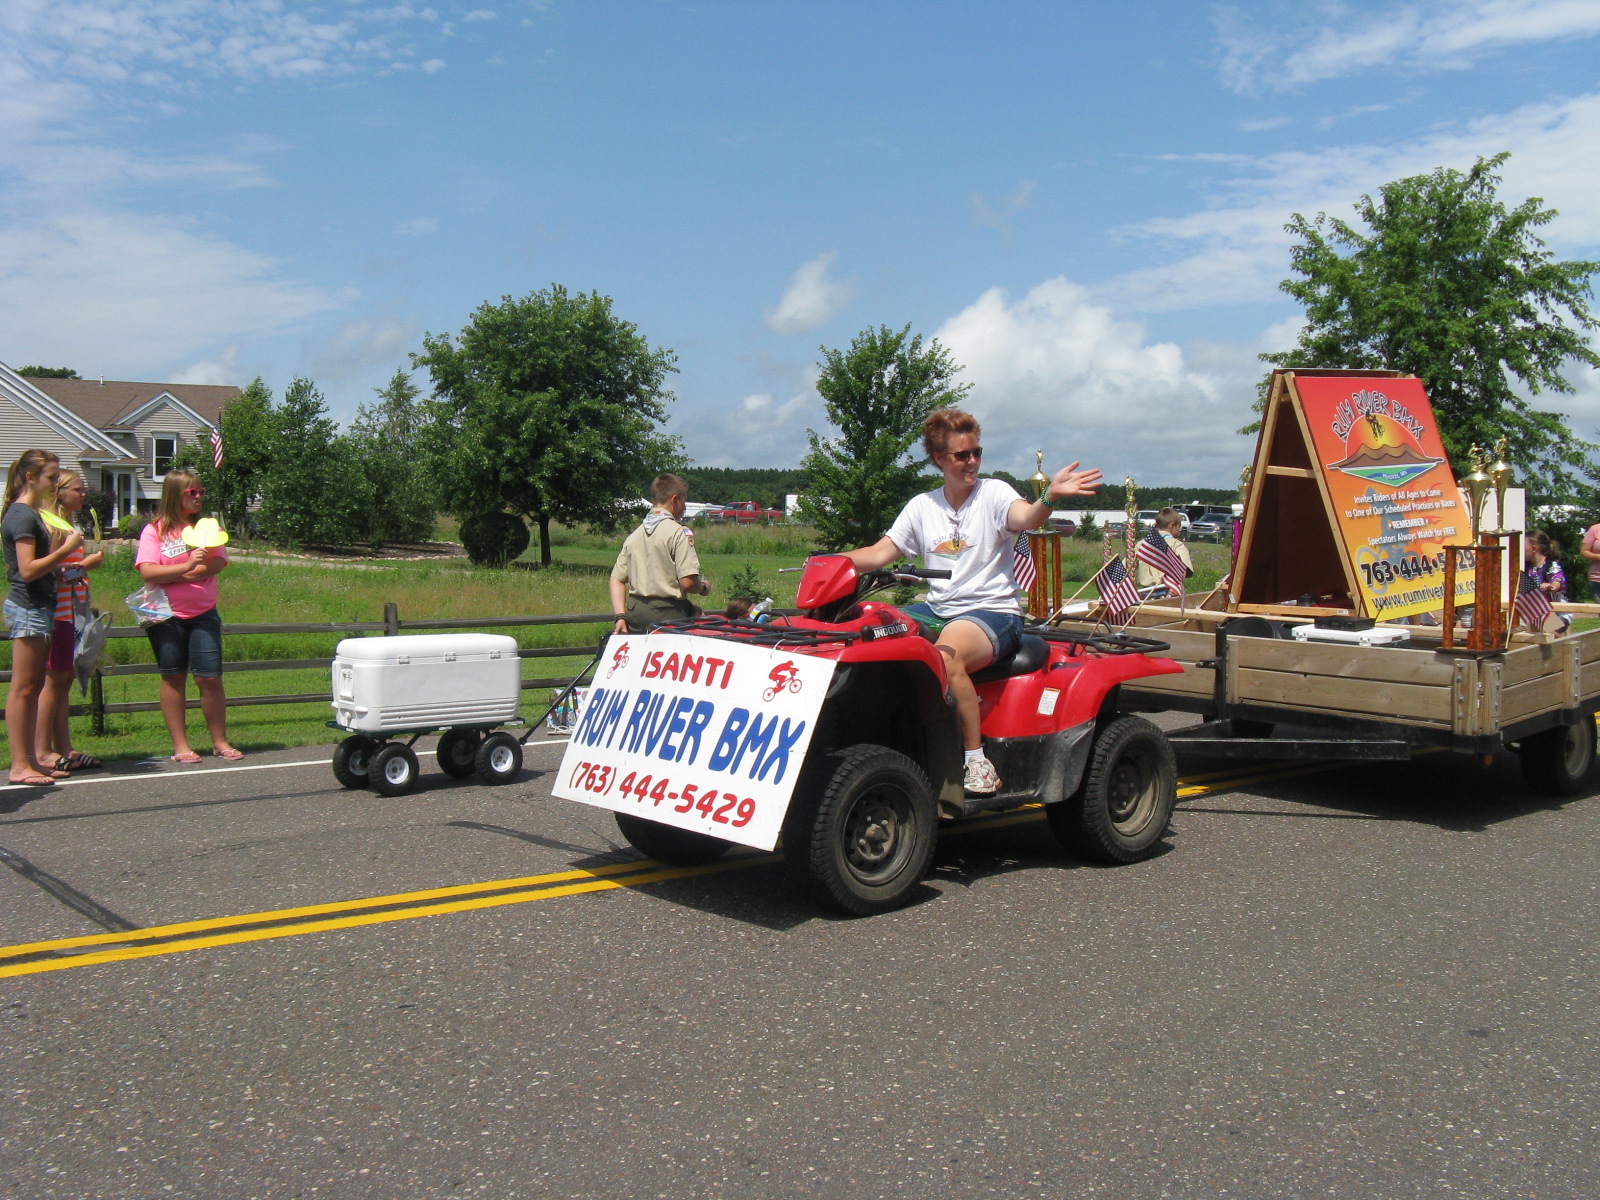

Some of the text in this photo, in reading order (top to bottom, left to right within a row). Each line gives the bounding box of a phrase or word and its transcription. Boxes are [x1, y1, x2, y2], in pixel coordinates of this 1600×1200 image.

[1332, 389, 1424, 443] RUM RIVER BMX
[1354, 494, 1373, 504] Invites
[1372, 492, 1390, 502] Riders
[1391, 491, 1397, 500] of
[1398, 490, 1406, 500] All
[1406, 490, 1420, 500] Ages
[1426, 488, 1442, 497] Come
[1346, 510, 1352, 518] to
[1352, 508, 1366, 517] One
[1366, 506, 1372, 516] of
[1372, 506, 1384, 515] Our
[1384, 503, 1412, 514] Scheduled
[1412, 502, 1434, 510] Practices
[1440, 500, 1456, 508] Races
[1392, 518, 1426, 529] REMEMBER
[1368, 526, 1456, 546] Spectators Always Watch for FREE
[874, 624, 908, 639] INGQUAD
[640, 651, 734, 689] ISANTI
[574, 688, 806, 785] RUM RIVER BMX
[569, 761, 756, 828] (763) 444-5429
